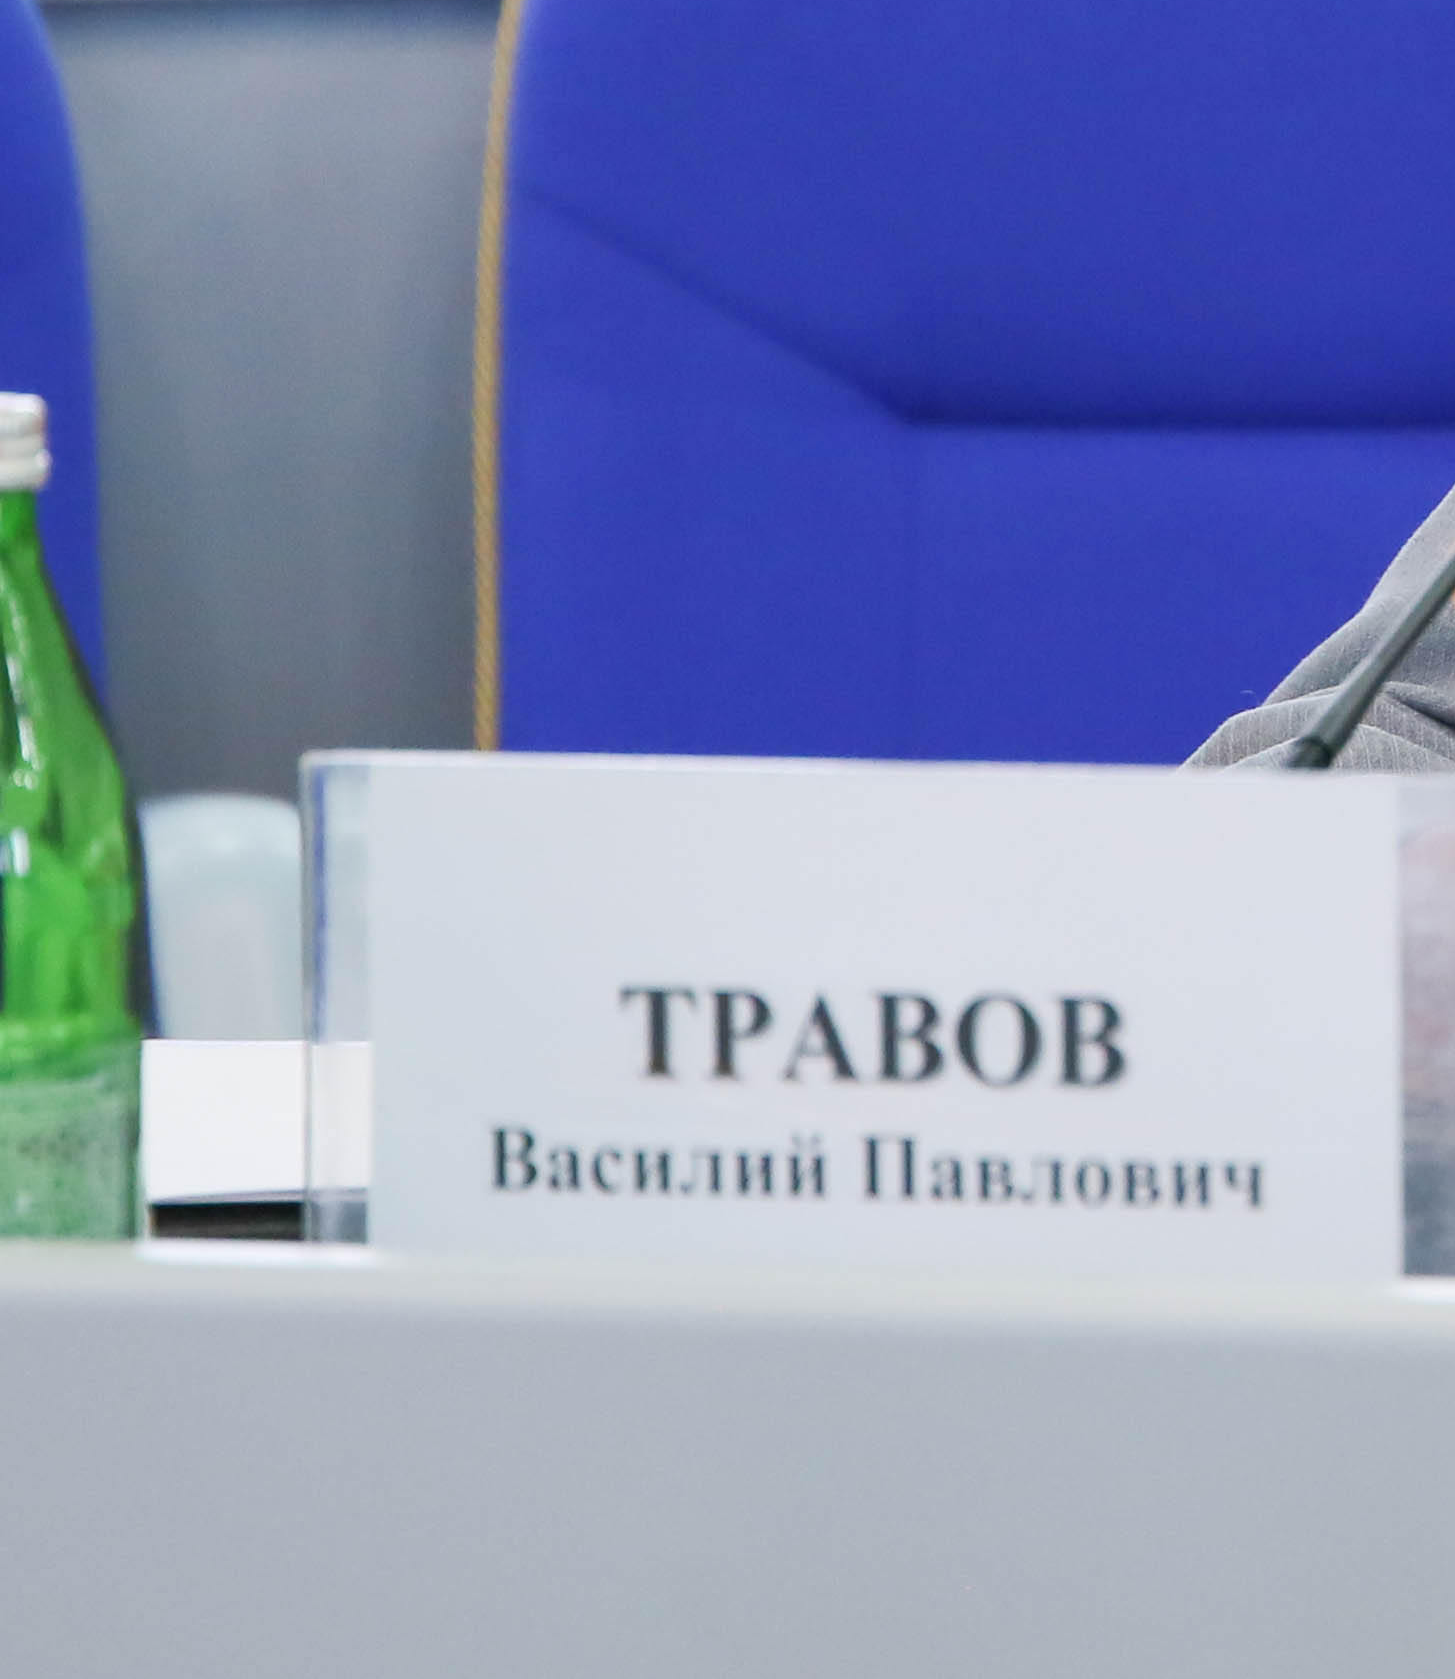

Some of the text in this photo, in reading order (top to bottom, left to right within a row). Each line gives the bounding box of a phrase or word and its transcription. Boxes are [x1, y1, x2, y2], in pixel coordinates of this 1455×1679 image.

[617, 982, 1130, 1091] ТРАВОВ
[489, 1122, 1266, 1211] Василий Павлович
